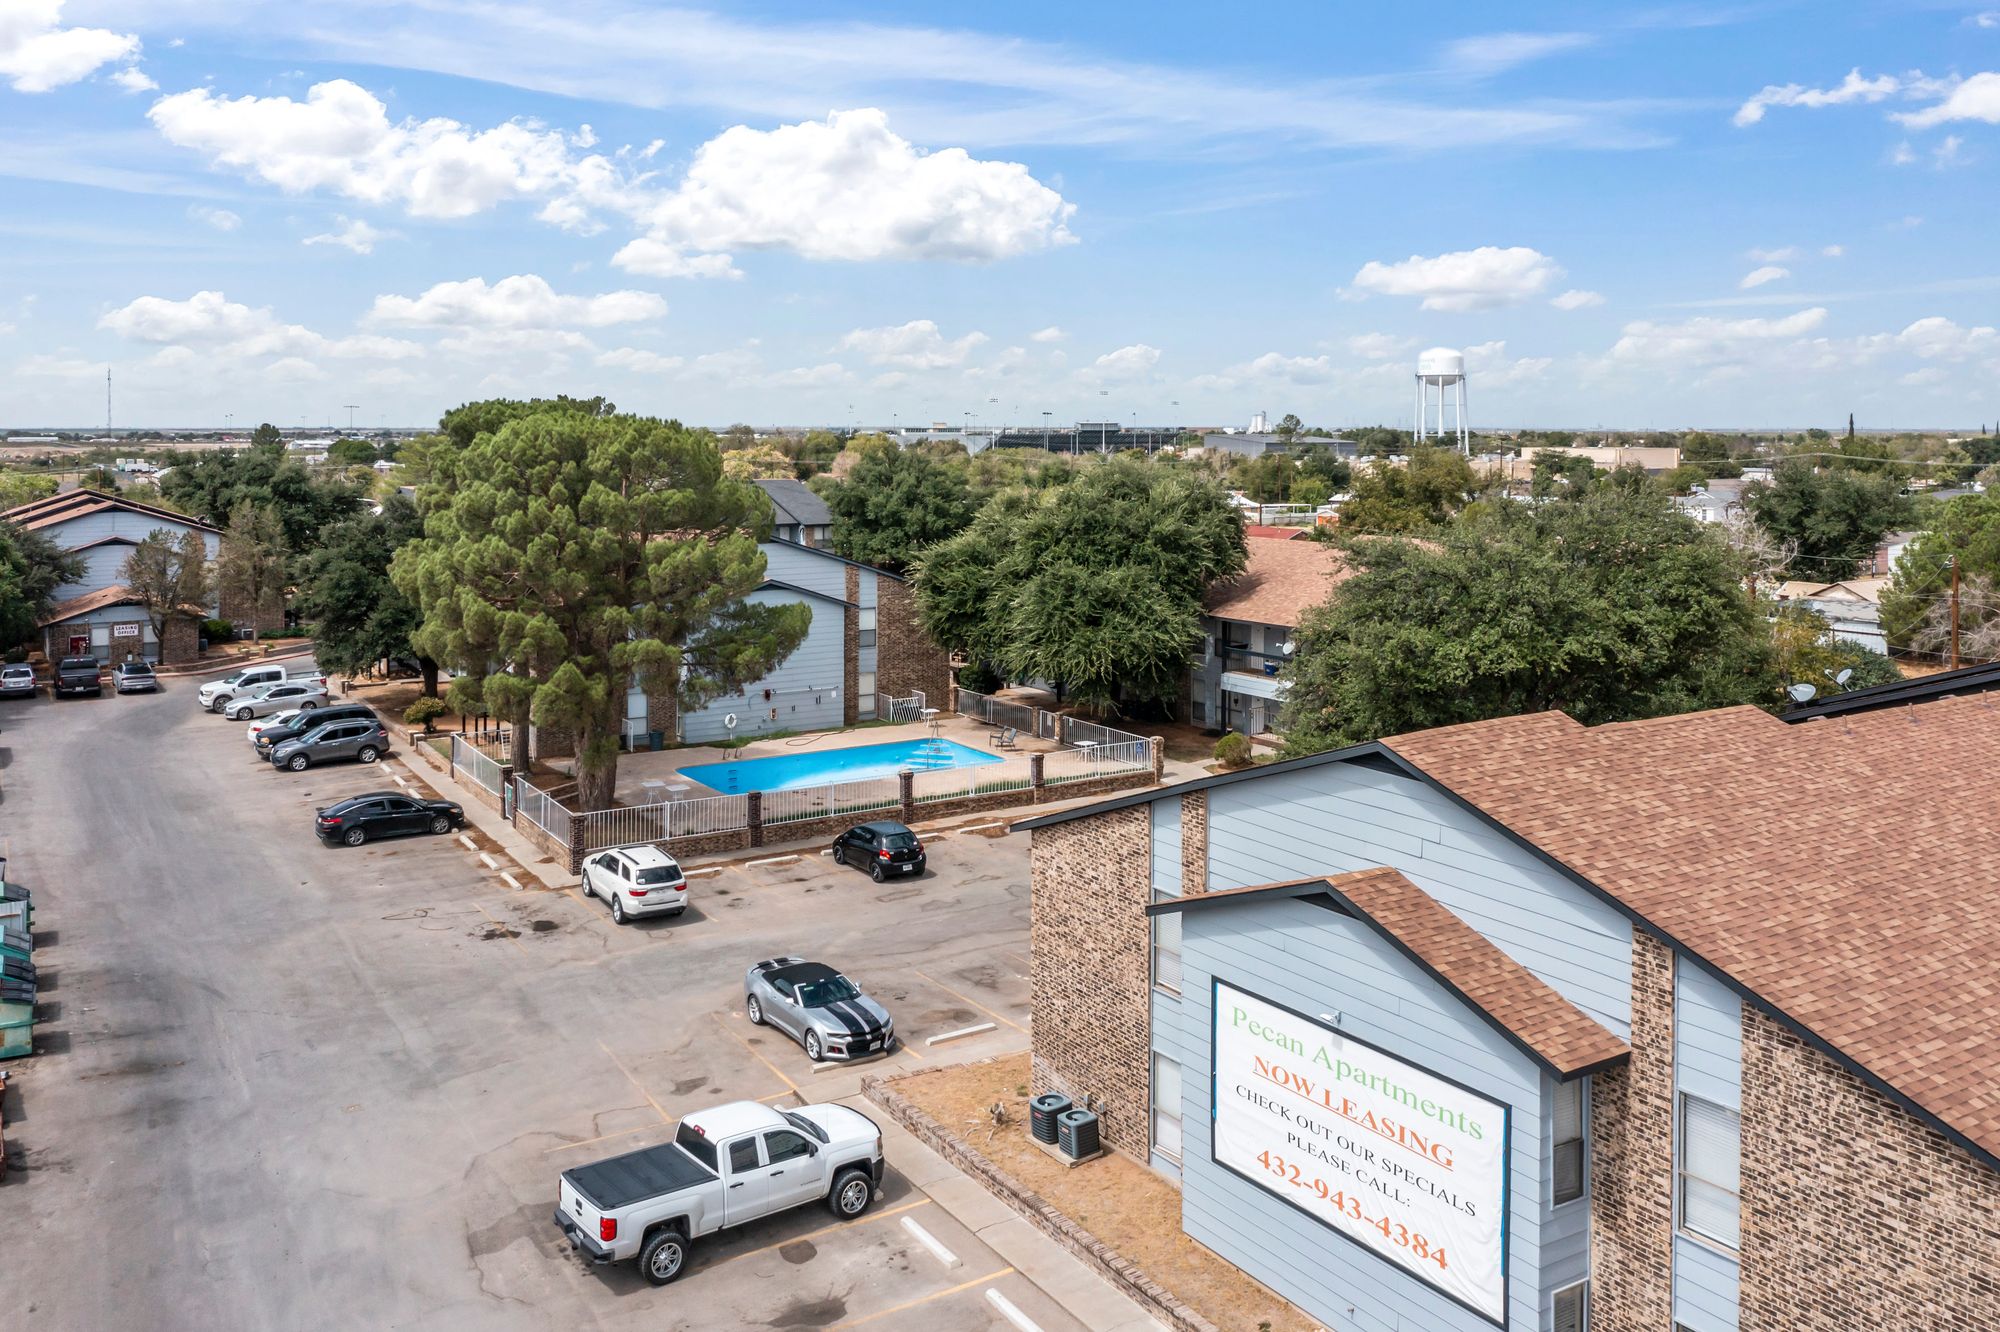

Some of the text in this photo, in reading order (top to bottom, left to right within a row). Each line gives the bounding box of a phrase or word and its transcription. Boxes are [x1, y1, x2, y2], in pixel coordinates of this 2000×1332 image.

[1232, 1006, 1483, 1141] Pecan Apartments
[1254, 1055, 1454, 1167] NOW LEASING
[1236, 1084, 1476, 1217] CHECK OUT OUR SPECIALS
[1256, 1150, 1448, 1270] 432-943-4384
[1287, 1131, 1410, 1207] PLEASE CALL:
